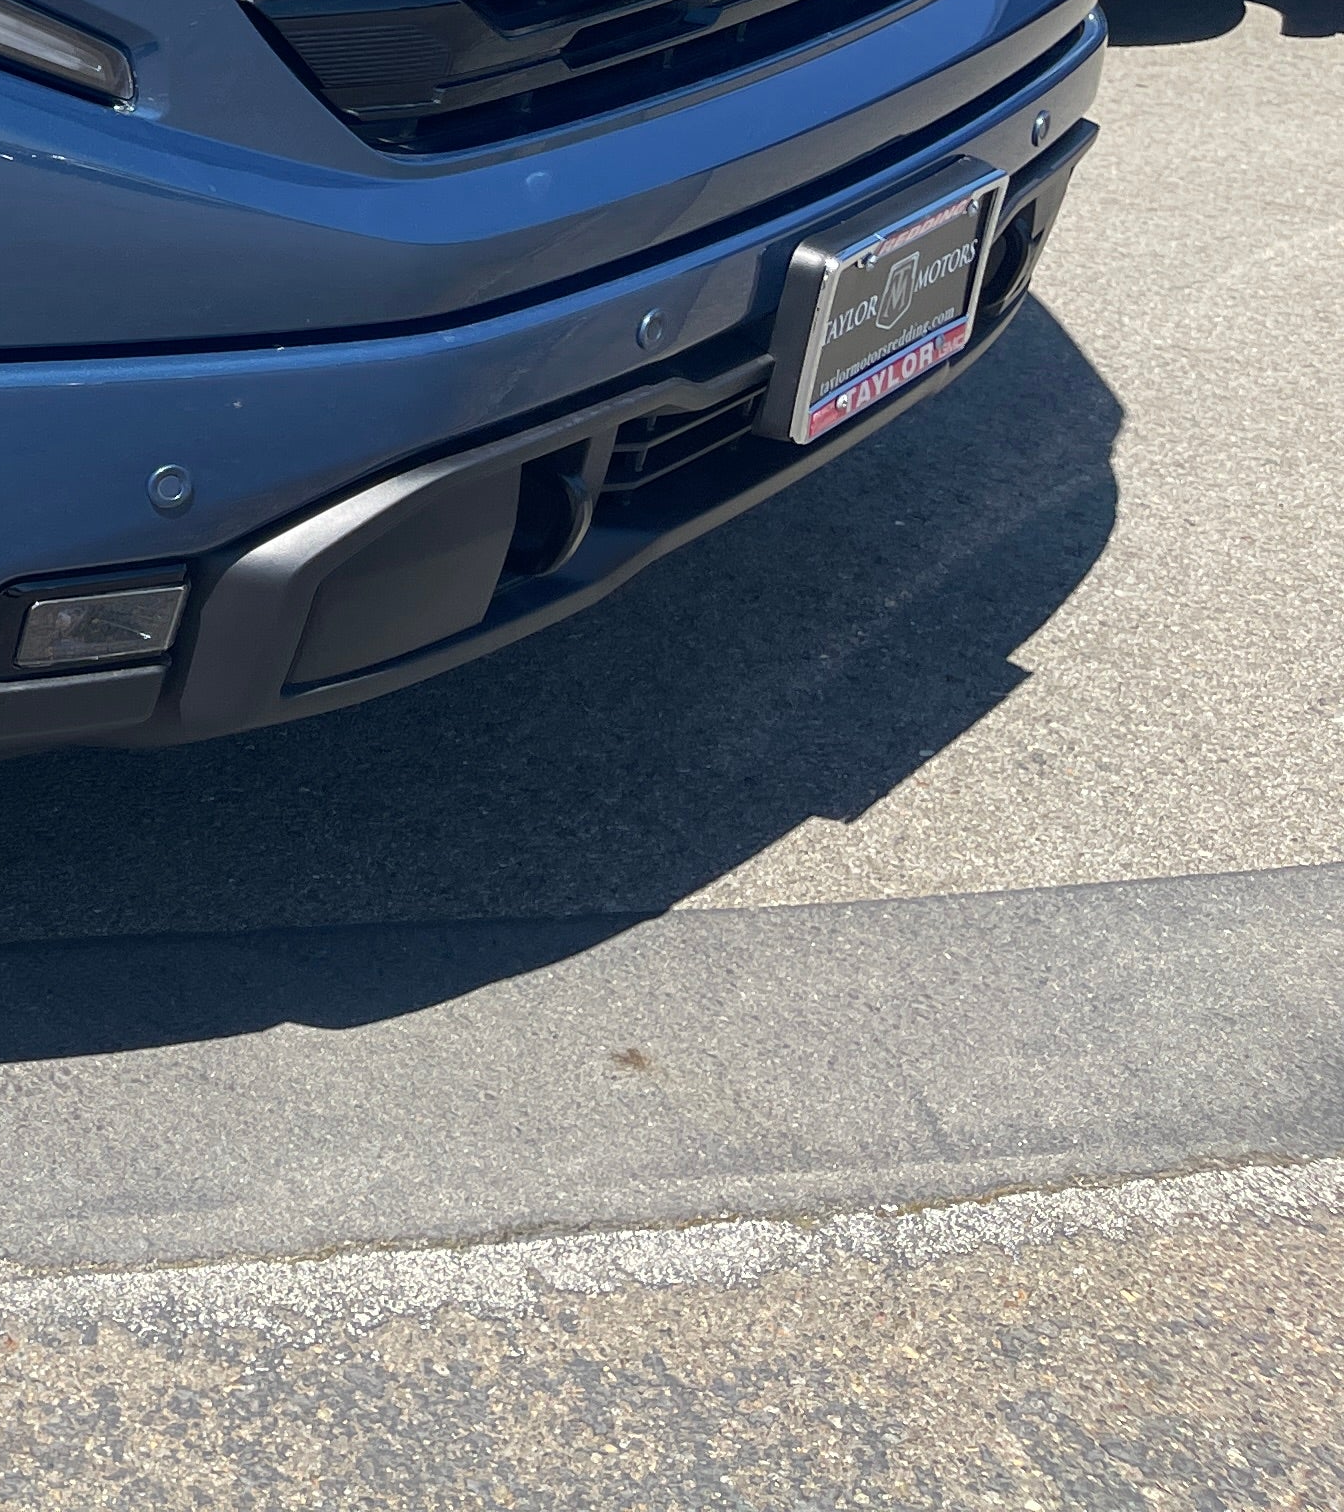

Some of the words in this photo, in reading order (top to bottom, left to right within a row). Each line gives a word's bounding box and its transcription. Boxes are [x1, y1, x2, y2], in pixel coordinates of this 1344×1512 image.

[822, 294, 879, 347] TAYLOR
[914, 239, 979, 293] MOTORS
[819, 306, 955, 396] taylormotorsredding.com
[844, 342, 935, 413] TAYLOR
